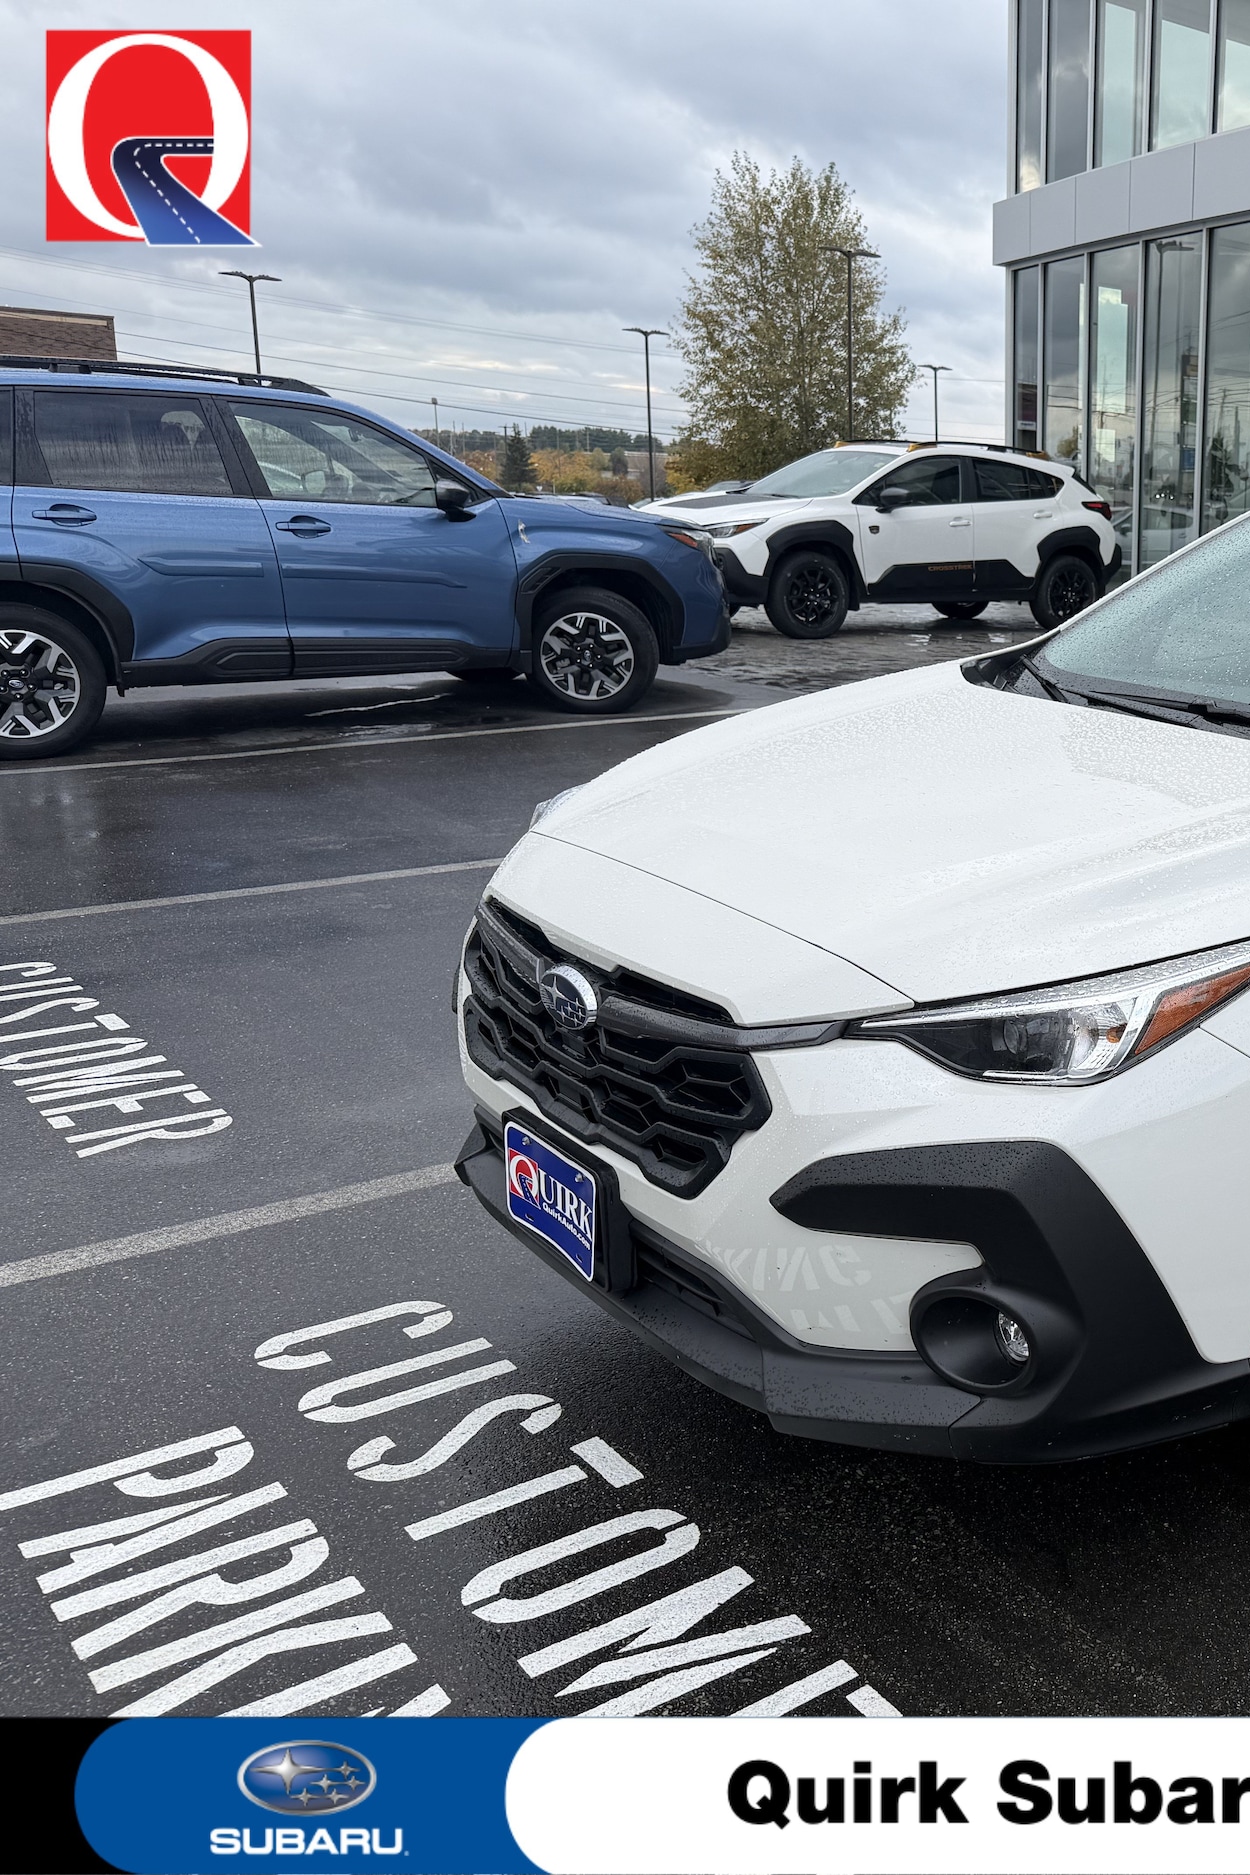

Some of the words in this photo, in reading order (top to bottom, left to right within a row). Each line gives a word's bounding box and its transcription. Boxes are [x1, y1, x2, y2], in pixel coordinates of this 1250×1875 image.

[510, 1155, 593, 1242] QUIRK
[542, 1202, 591, 1250] QuirkAuto.com
[0, 1425, 452, 1716] PARKI
